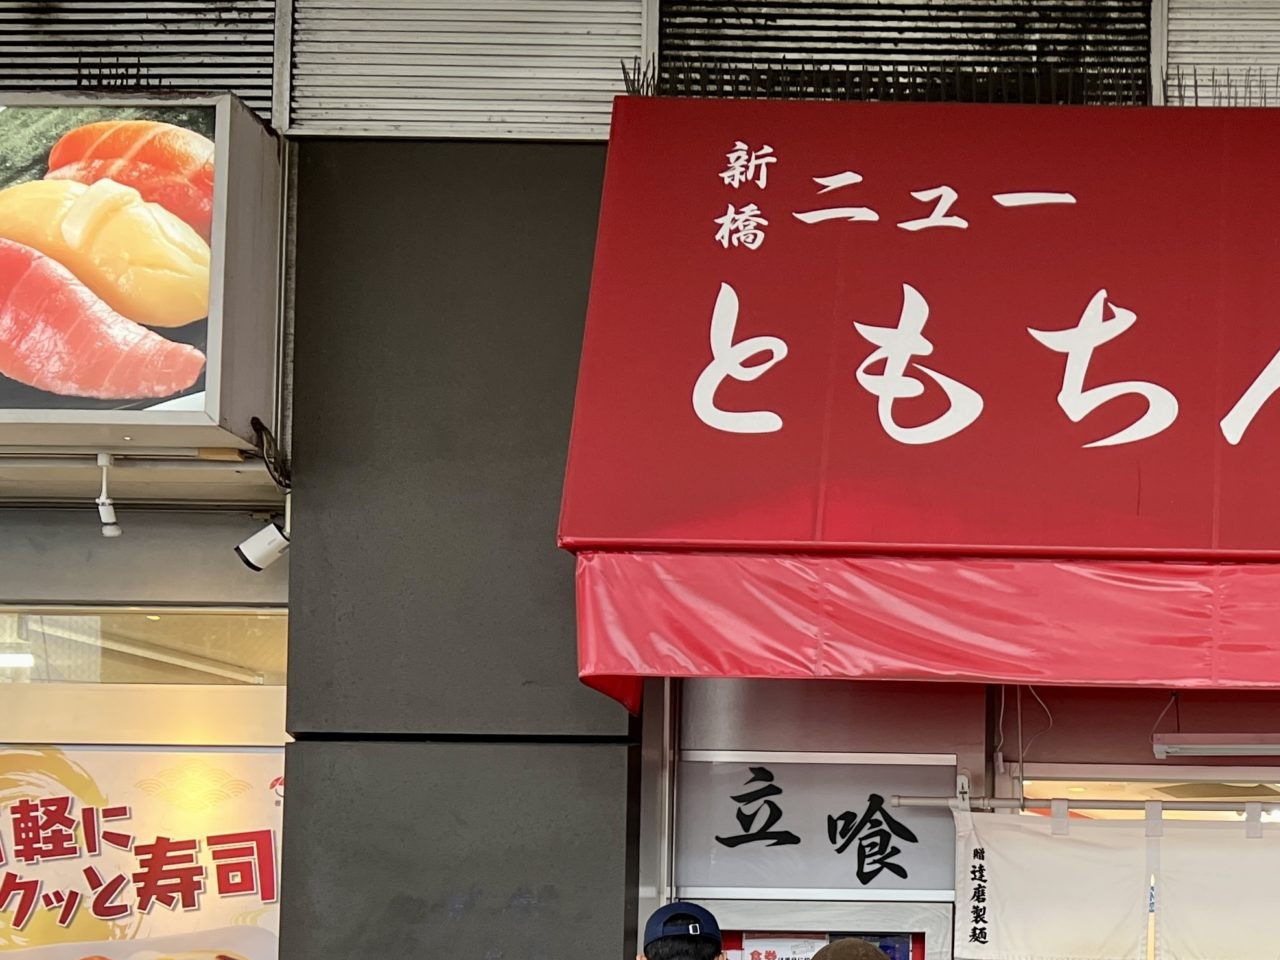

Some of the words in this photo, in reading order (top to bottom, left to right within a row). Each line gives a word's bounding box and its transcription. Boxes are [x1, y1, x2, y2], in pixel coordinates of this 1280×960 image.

[714, 141, 777, 250] 新橋
[792, 171, 1077, 231] ニュー
[0, 796, 132, 866] 軽に
[715, 766, 919, 885] 立喰
